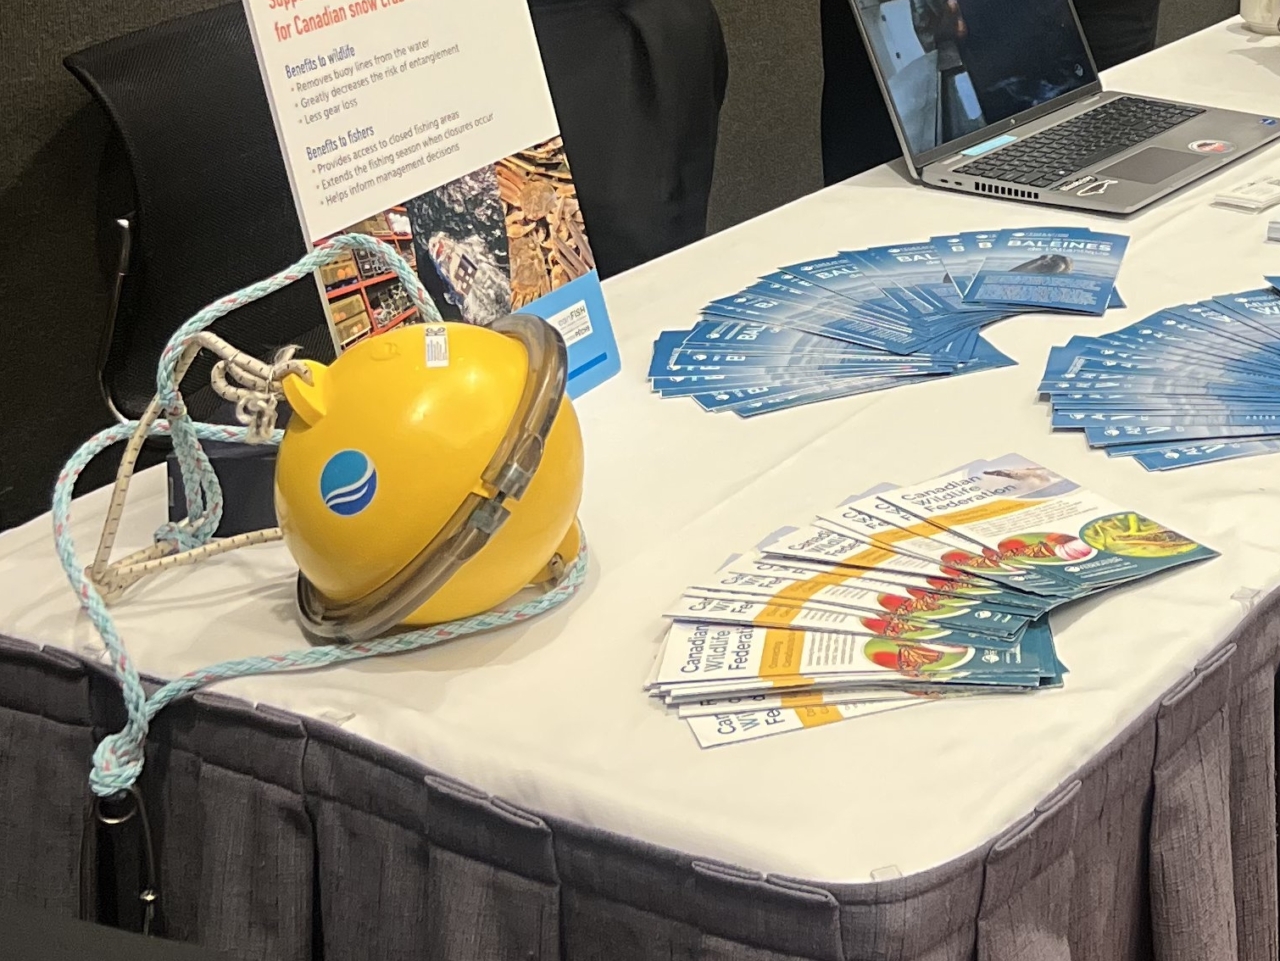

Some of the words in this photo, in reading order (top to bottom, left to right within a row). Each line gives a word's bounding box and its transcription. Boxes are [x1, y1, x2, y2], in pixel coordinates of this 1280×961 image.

[274, 21, 292, 42] for
[293, 4, 348, 35] Canadian
[284, 58, 318, 79] Benefits
[318, 54, 327, 67] to
[327, 44, 356, 65] wildlife
[296, 72, 333, 93] Removes
[333, 66, 354, 80] buoy
[354, 57, 373, 73] lines
[374, 51, 393, 66] from
[394, 46, 407, 59] the
[407, 38, 430, 54] water
[300, 89, 330, 109] Greatly
[331, 75, 370, 98] decreases
[370, 70, 384, 83] the
[384, 64, 398, 79] risk
[399, 60, 408, 73] of
[409, 43, 460, 70] entanglement
[304, 110, 322, 125] Less
[323, 103, 341, 121] gear
[342, 97, 358, 111] loss
[306, 138, 338, 161] Benefits
[338, 135, 347, 148] to
[347, 125, 375, 145] fishers
[317, 153, 352, 174] Provides
[352, 144, 378, 161] access
[378, 139, 388, 149] to
[388, 129, 413, 145] closed
[414, 119, 439, 136] fishing
[440, 110, 460, 125] areas
[321, 169, 354, 190] Extends
[354, 163, 369, 176] the
[368, 152, 395, 171] fishing
[395, 142, 422, 159] season
[422, 134, 443, 150] when
[443, 121, 474, 140] closures
[473, 112, 494, 127] occur
[325, 190, 349, 206] Helps
[349, 176, 376, 196] inform
[376, 156, 425, 187] management
[426, 142, 460, 162] decisions
[1007, 239, 1111, 252] BALEINES
[901, 474, 981, 501] Canadian
[911, 485, 981, 507] Wildlife
[923, 484, 1017, 512] Federation
[680, 623, 710, 674] Canadian
[704, 630, 731, 673] Wildlife
[728, 625, 754, 671] Federati
